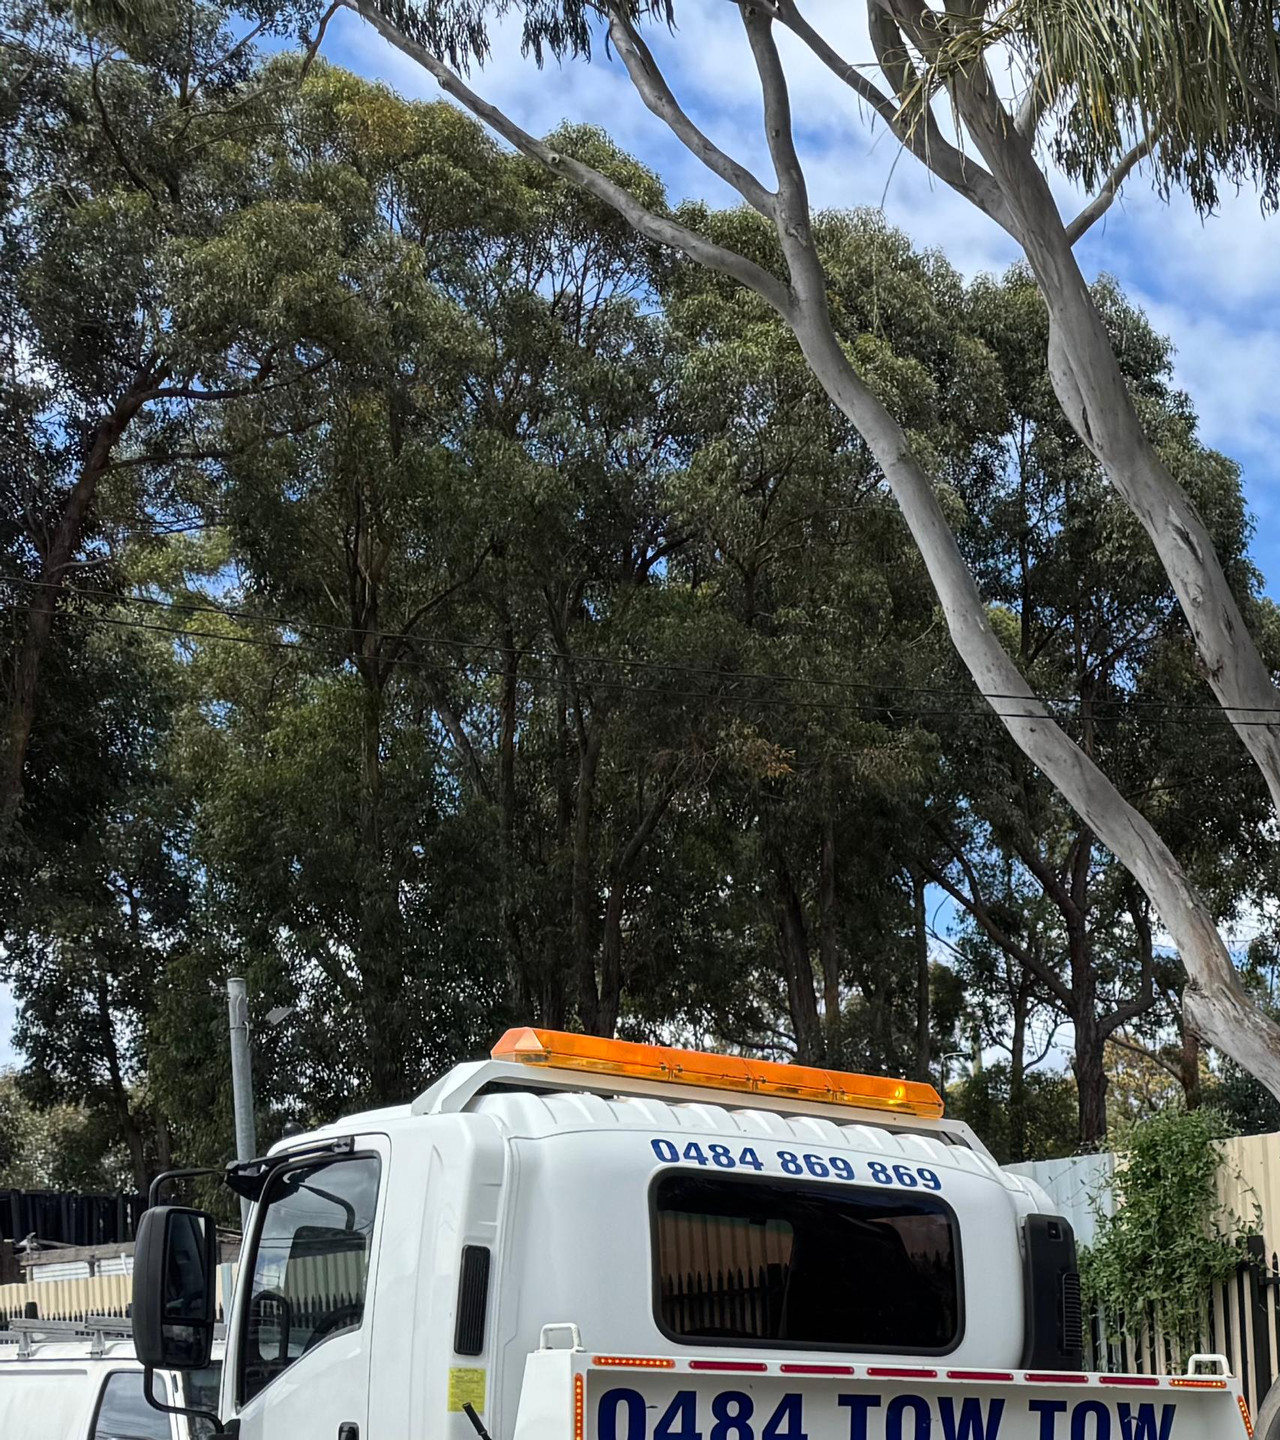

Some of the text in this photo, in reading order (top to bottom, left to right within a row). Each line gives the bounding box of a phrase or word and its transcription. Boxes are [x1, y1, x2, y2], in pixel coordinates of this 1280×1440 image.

[651, 1139, 942, 1192] 0484 869 869
